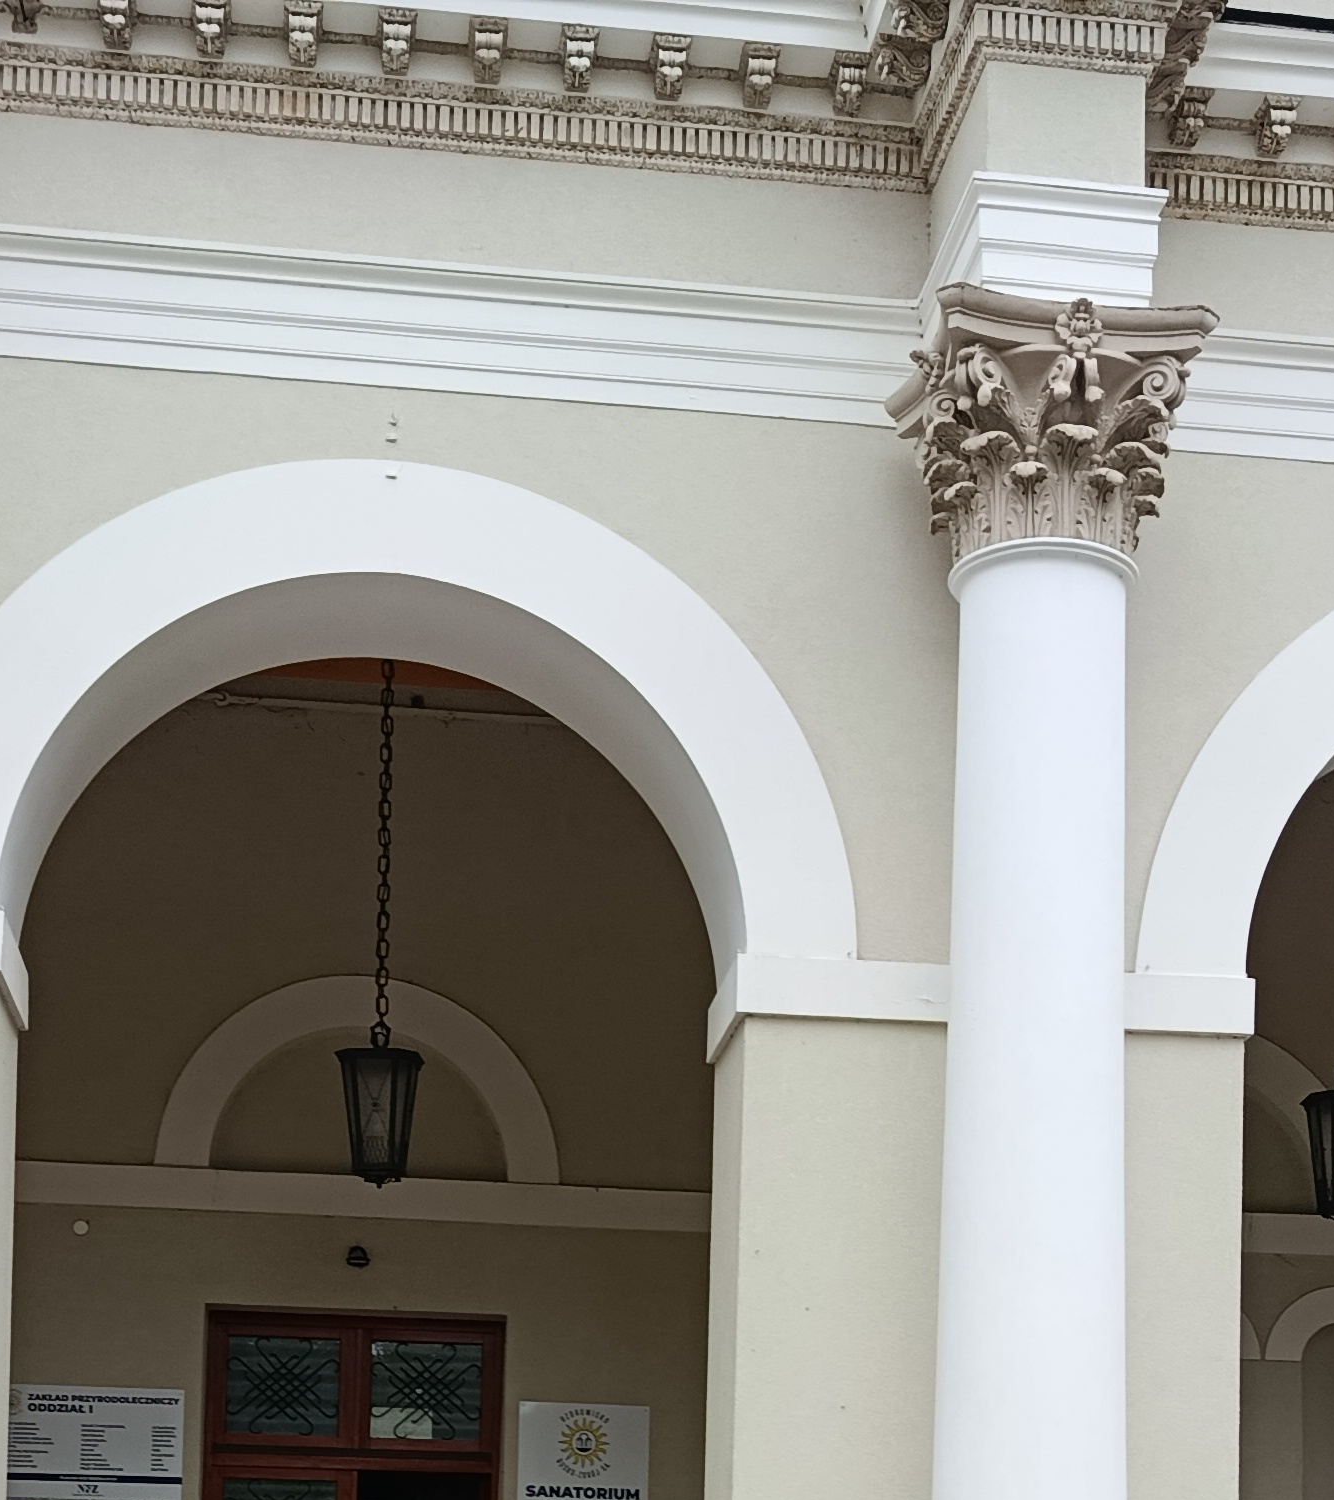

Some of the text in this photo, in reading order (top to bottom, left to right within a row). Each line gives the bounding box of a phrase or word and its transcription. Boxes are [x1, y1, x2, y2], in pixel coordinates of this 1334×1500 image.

[28, 1393, 180, 1405] ZAKŁAD PRZYRODOLECZNICZY
[28, 1403, 86, 1413] ODDZIAŁ
[525, 1485, 640, 1500] SANATORIUM
